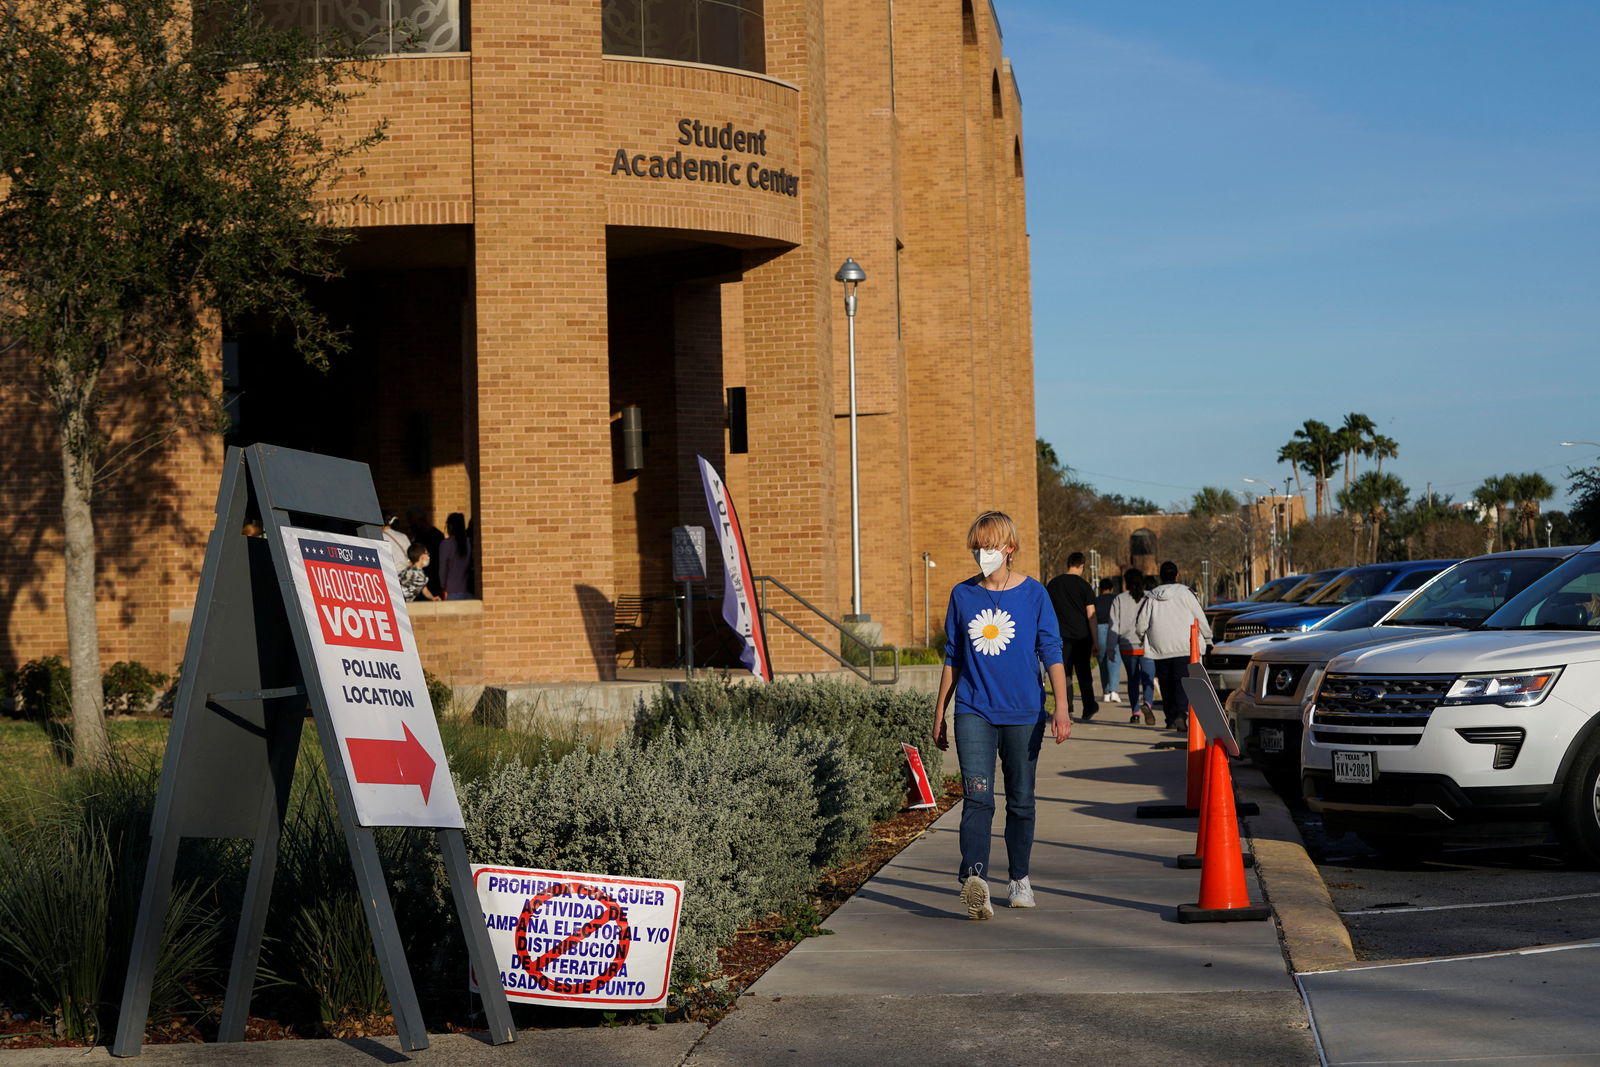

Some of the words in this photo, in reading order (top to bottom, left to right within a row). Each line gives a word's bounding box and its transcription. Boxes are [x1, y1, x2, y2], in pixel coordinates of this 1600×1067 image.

[678, 119, 766, 156] Student
[611, 149, 741, 185] Academic
[747, 162, 799, 197] Center
[327, 546, 354, 562] UTRGV
[311, 566, 386, 605] VAQUEROS
[321, 604, 394, 642] VOTE
[341, 658, 402, 681] POLLING
[342, 685, 415, 708] LOCATION
[489, 876, 573, 899] PROHIBIDA
[577, 884, 665, 906] CUALQUIER
[522, 898, 605, 920] ACTIVIDAD
[609, 906, 629, 922] DE
[554, 920, 641, 942] ELECTORAL
[647, 927, 670, 944] Y/O
[518, 936, 627, 959] DISTRIBUCIÓN
[511, 954, 532, 971] DE
[536, 957, 628, 978] LITERATURA
[500, 971, 549, 991] ASADO
[554, 977, 592, 994] ESTE
[596, 980, 646, 996] PUNTO
